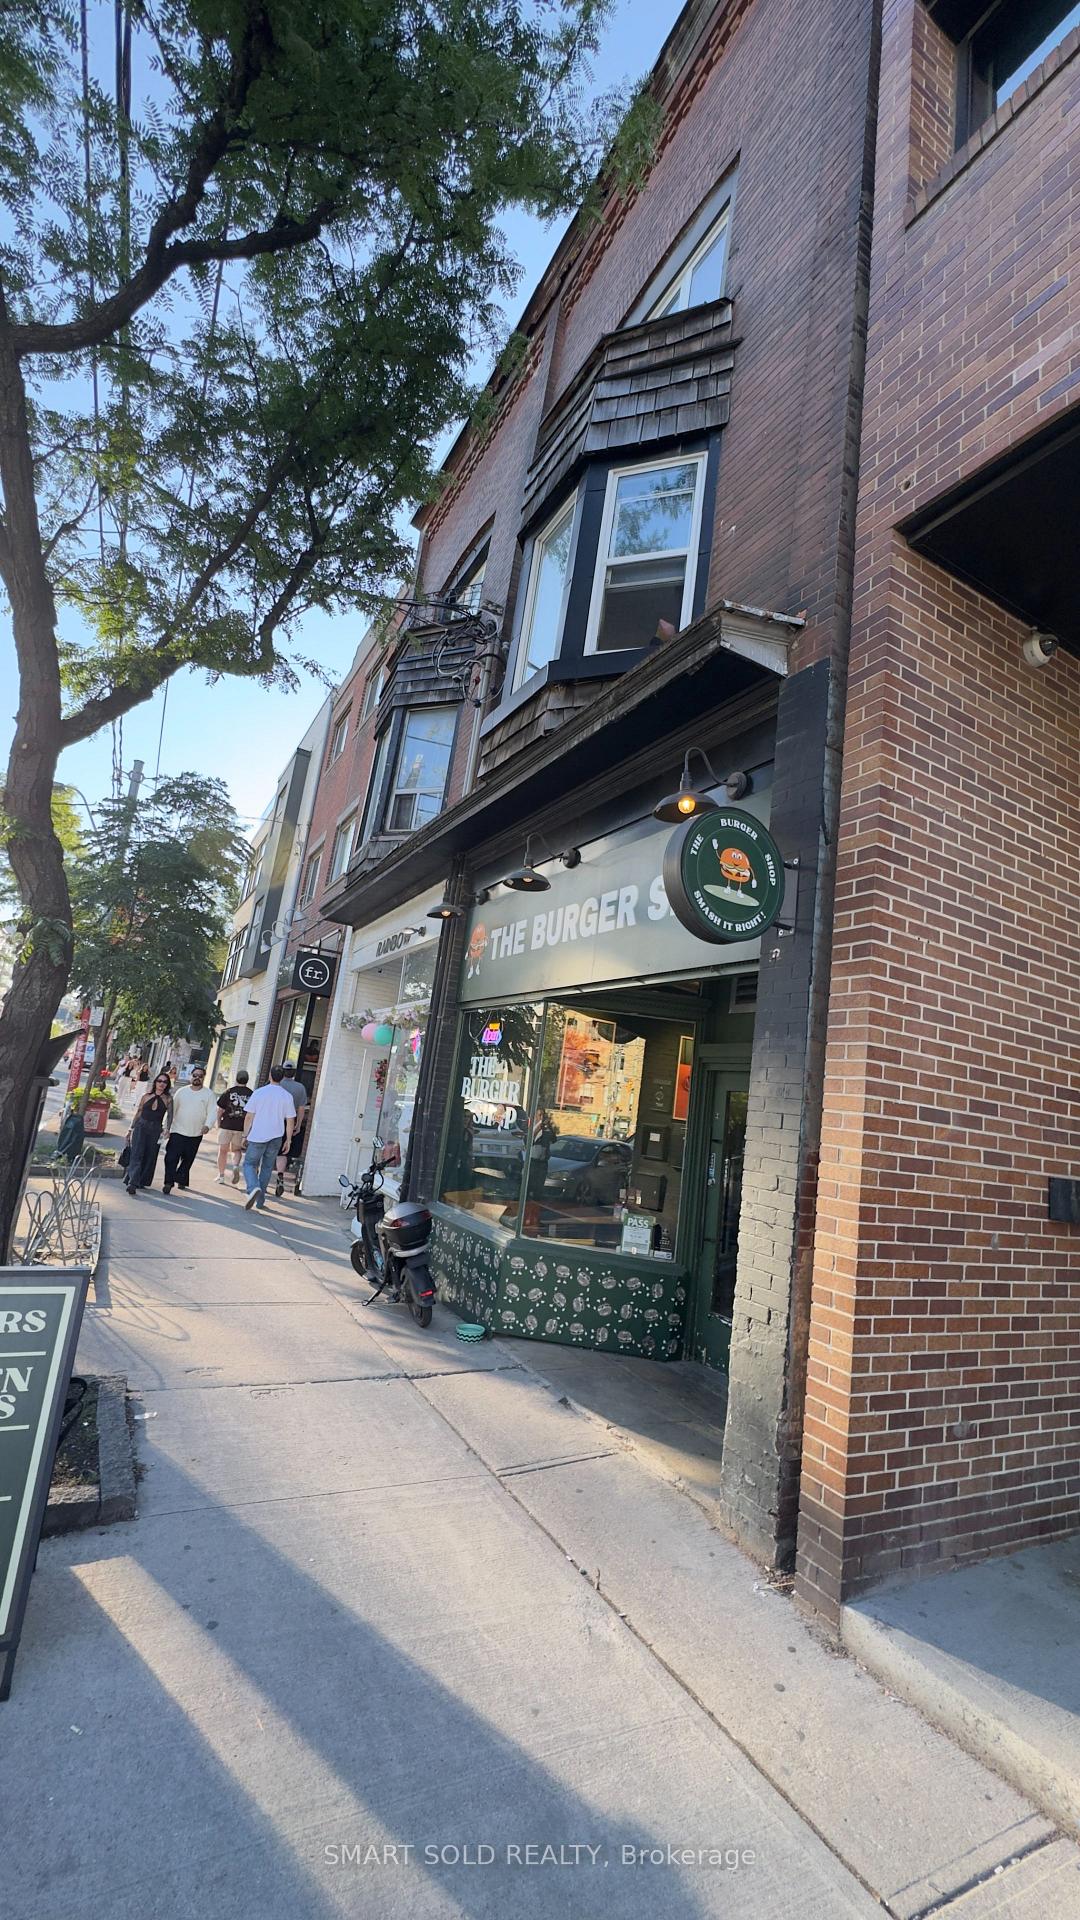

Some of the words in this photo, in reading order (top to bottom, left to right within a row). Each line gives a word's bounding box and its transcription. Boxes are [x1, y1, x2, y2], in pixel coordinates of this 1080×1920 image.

[690, 833, 704, 856] THE
[720, 818, 758, 841] BURGER
[764, 853, 776, 886] SHOP
[490, 920, 527, 961] THE
[530, 885, 639, 951] BURGER
[693, 890, 721, 926] SMASH
[723, 921, 734, 931] IT
[469, 1056, 498, 1078] THE
[461, 1076, 520, 1106] BURGER
[627, 1217, 649, 1228] PASS
[0, 1366, 34, 1393] N
